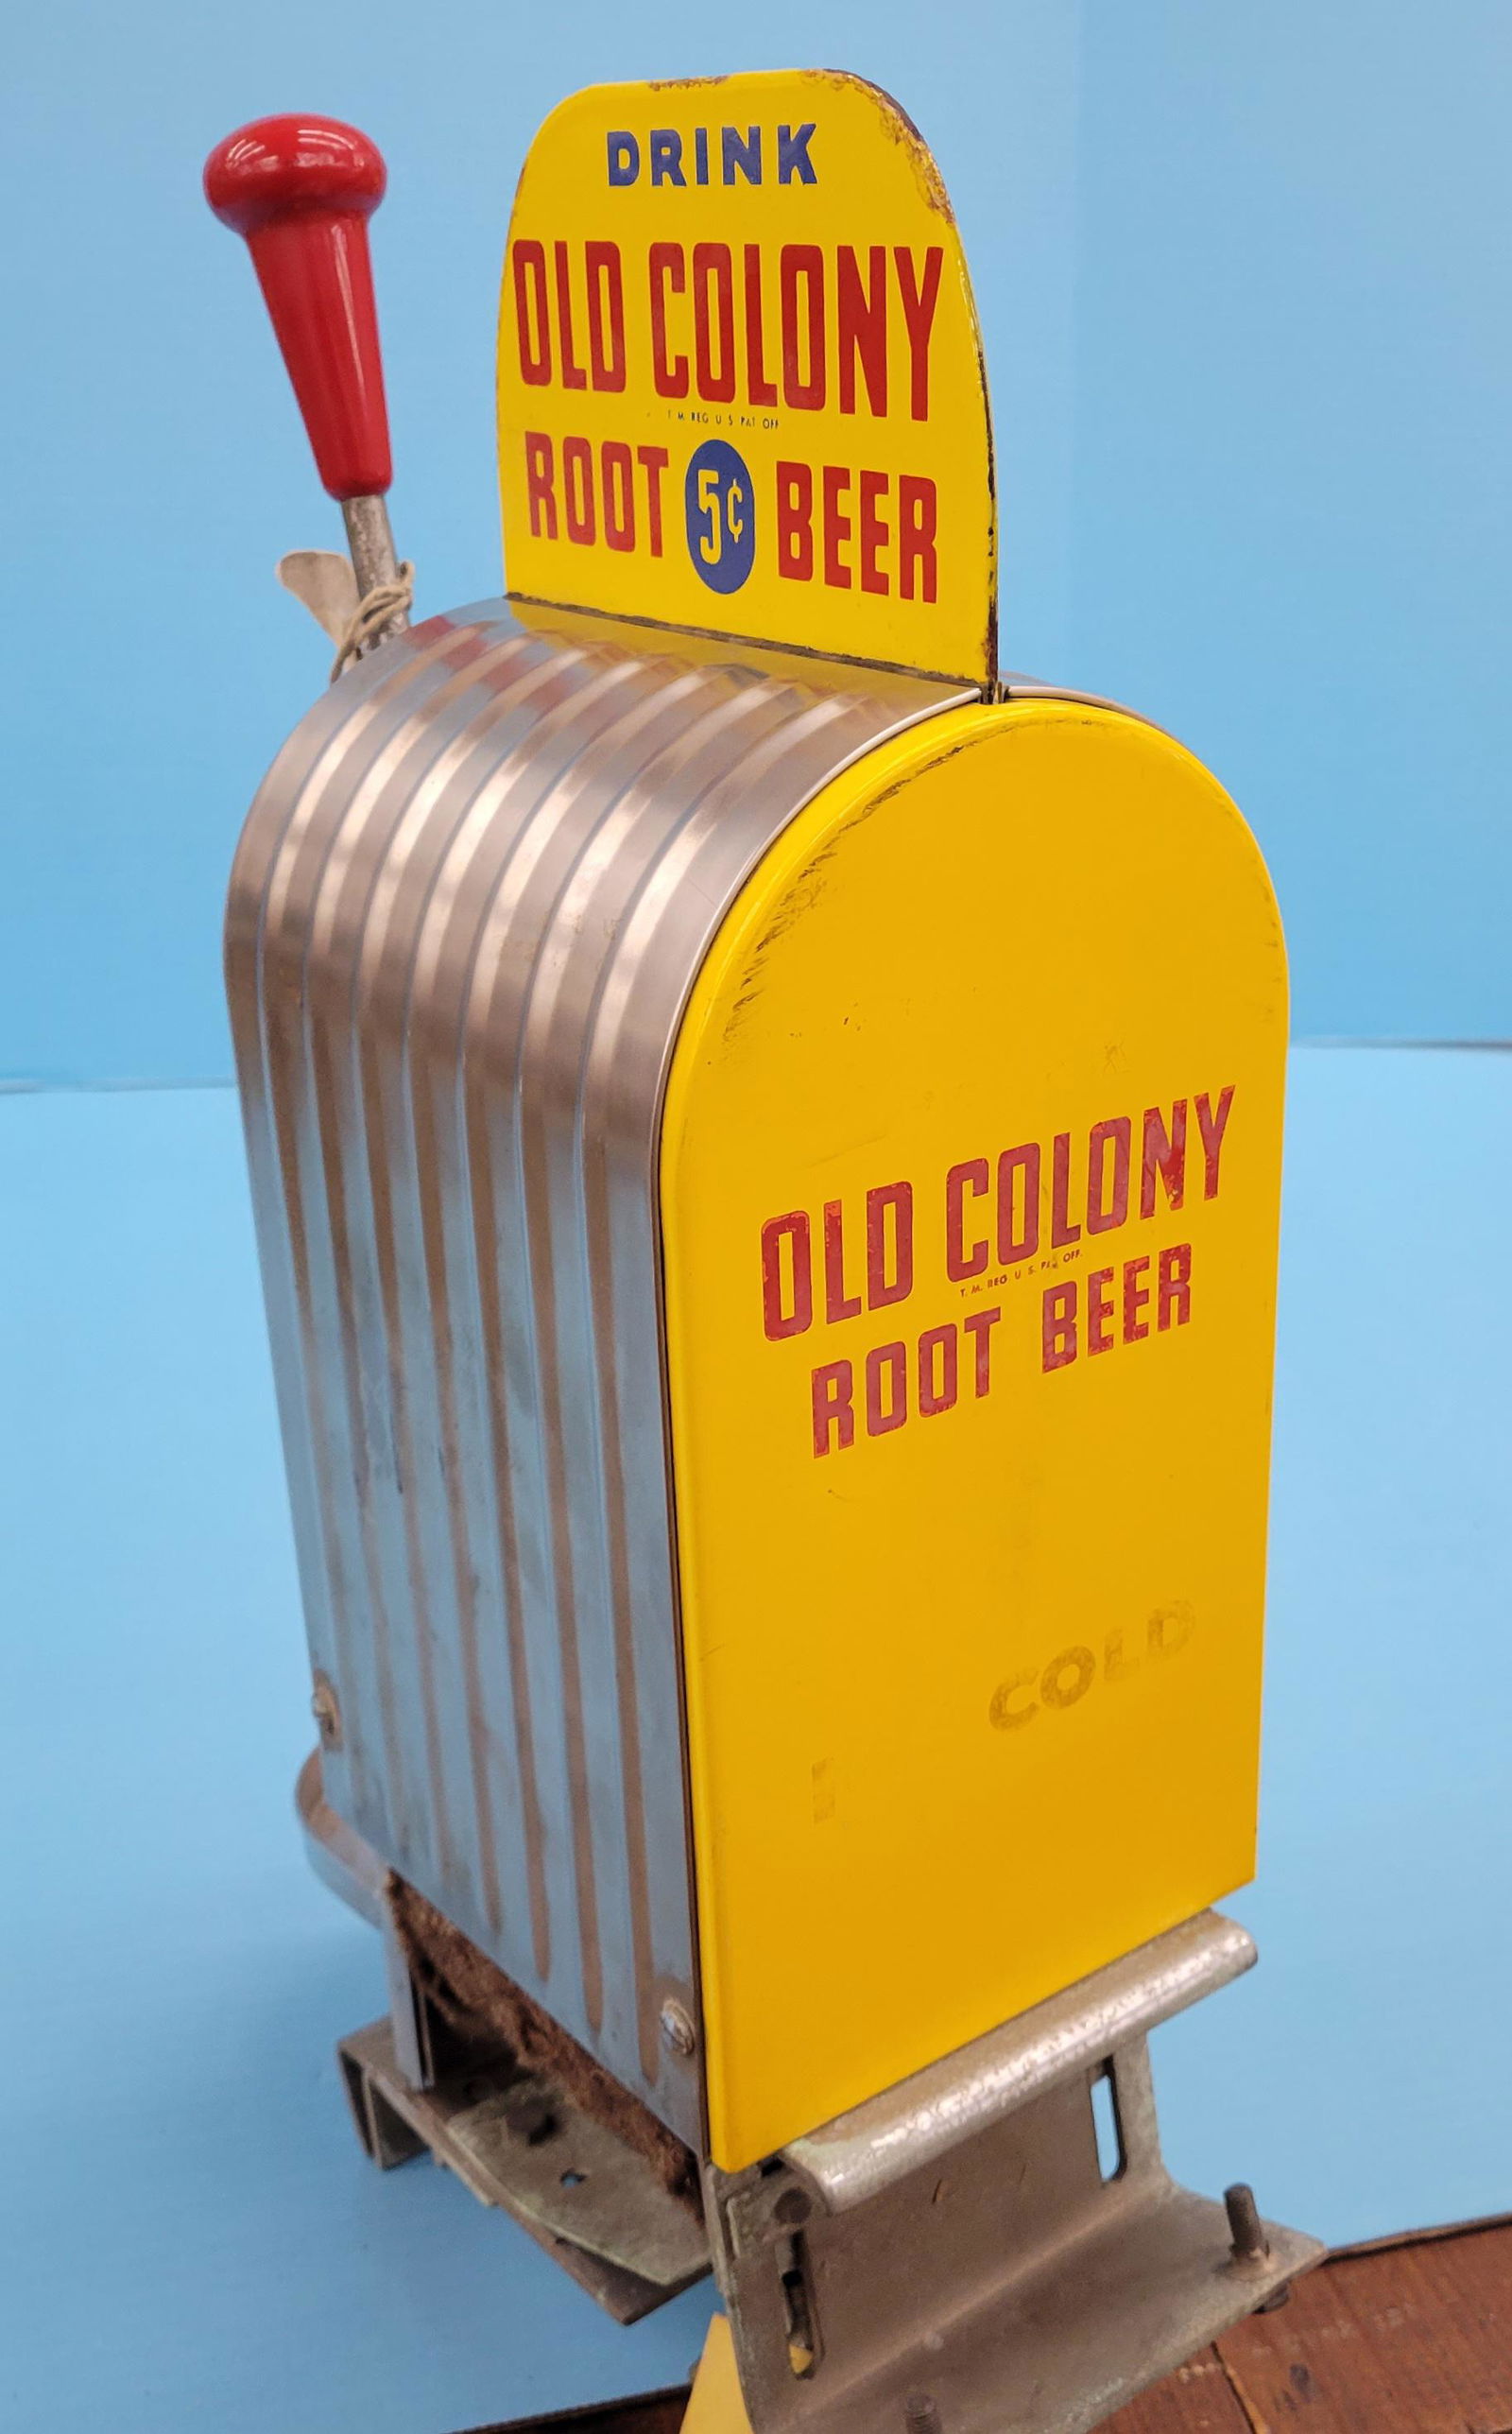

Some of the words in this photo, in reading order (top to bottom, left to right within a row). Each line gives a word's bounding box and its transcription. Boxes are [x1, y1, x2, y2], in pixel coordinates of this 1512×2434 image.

[606, 123, 817, 186] DRINK
[512, 240, 627, 393] OLD
[648, 241, 944, 423] COLONY
[525, 430, 668, 558] ROOT
[697, 469, 744, 565] 5¢
[776, 460, 937, 604] BEER
[761, 1181, 913, 1342] OLD
[946, 1084, 1236, 1284] COLONY
[812, 1306, 1001, 1459] ROOT
[1041, 1243, 1192, 1374] BEER
[988, 1598, 1195, 1731] COLD
